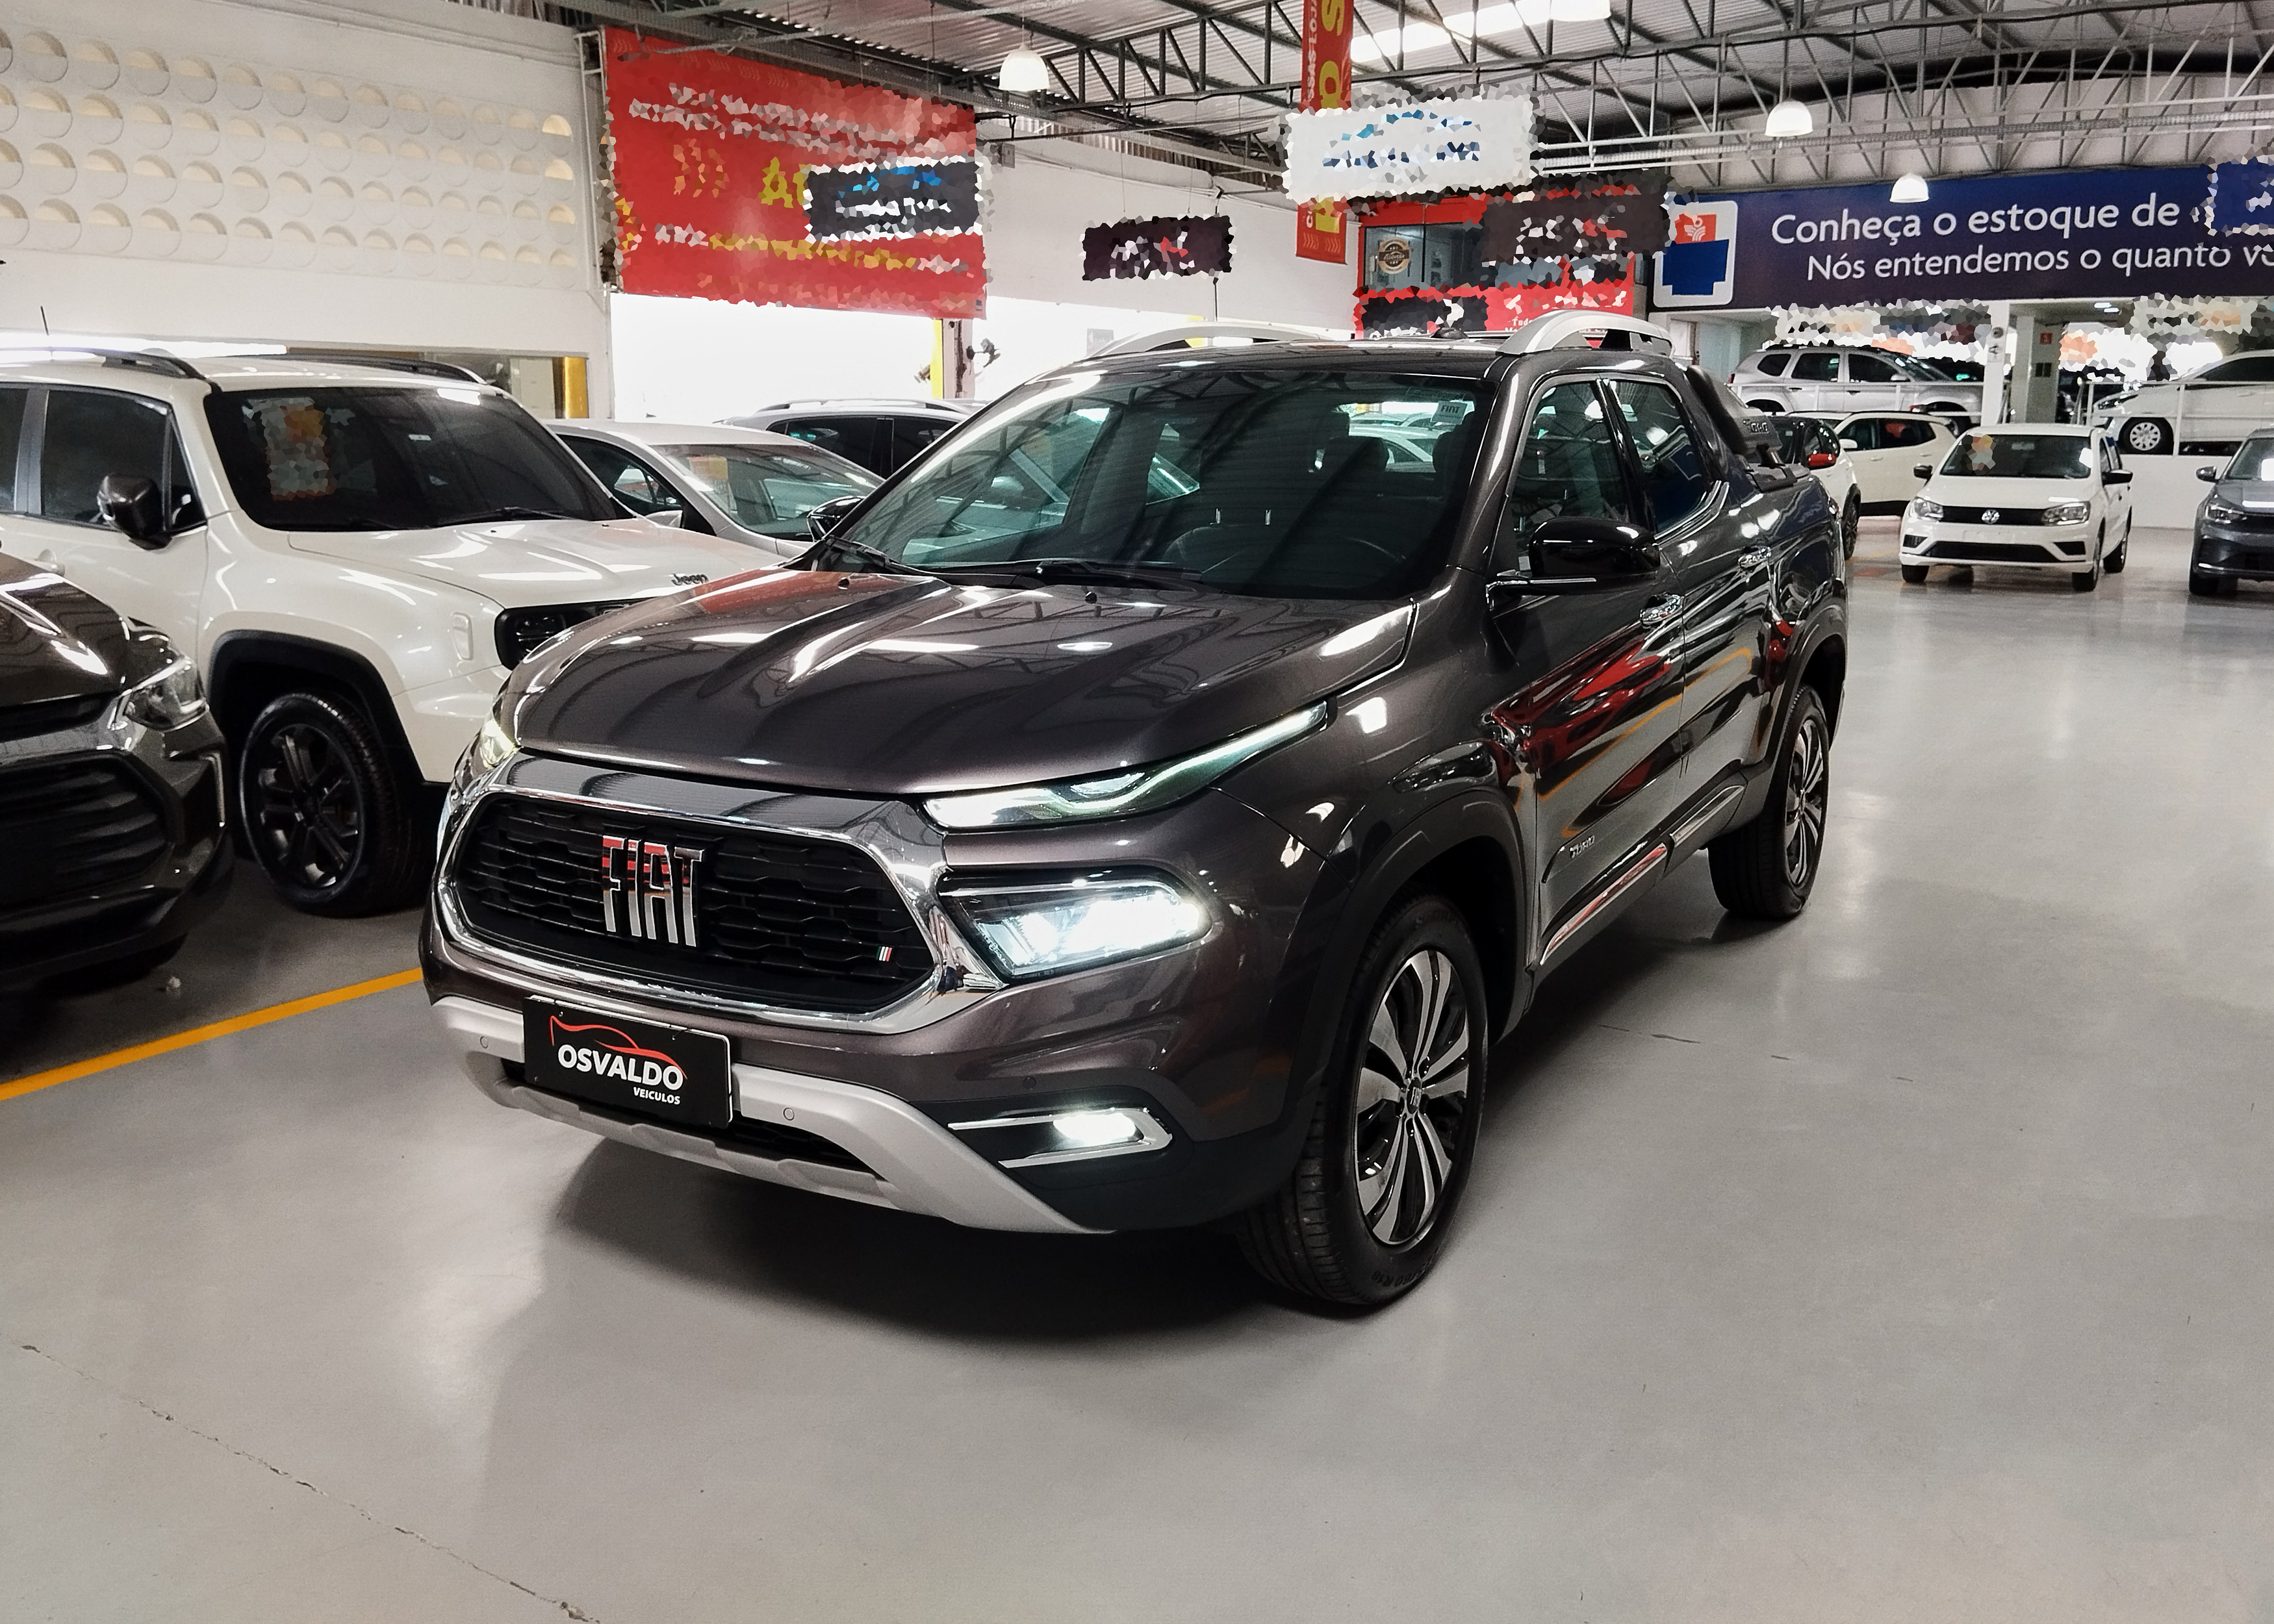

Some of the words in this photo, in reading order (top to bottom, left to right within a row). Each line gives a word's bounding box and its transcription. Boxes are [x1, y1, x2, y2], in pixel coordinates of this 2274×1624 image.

[1772, 208, 1921, 246] Conheça
[1933, 212, 1957, 236] o
[1968, 200, 2119, 239] estoque
[2132, 192, 2180, 227] de
[1808, 253, 1865, 281] Nós
[1874, 244, 2069, 277] entendemos
[2080, 249, 2102, 269] o
[2112, 246, 2231, 277] quanto
[1440, 405, 1461, 414] FIAT
[602, 835, 705, 947] FIAT
[558, 1044, 683, 1091] OSVALDO
[633, 1086, 681, 1105] VEICULOS
